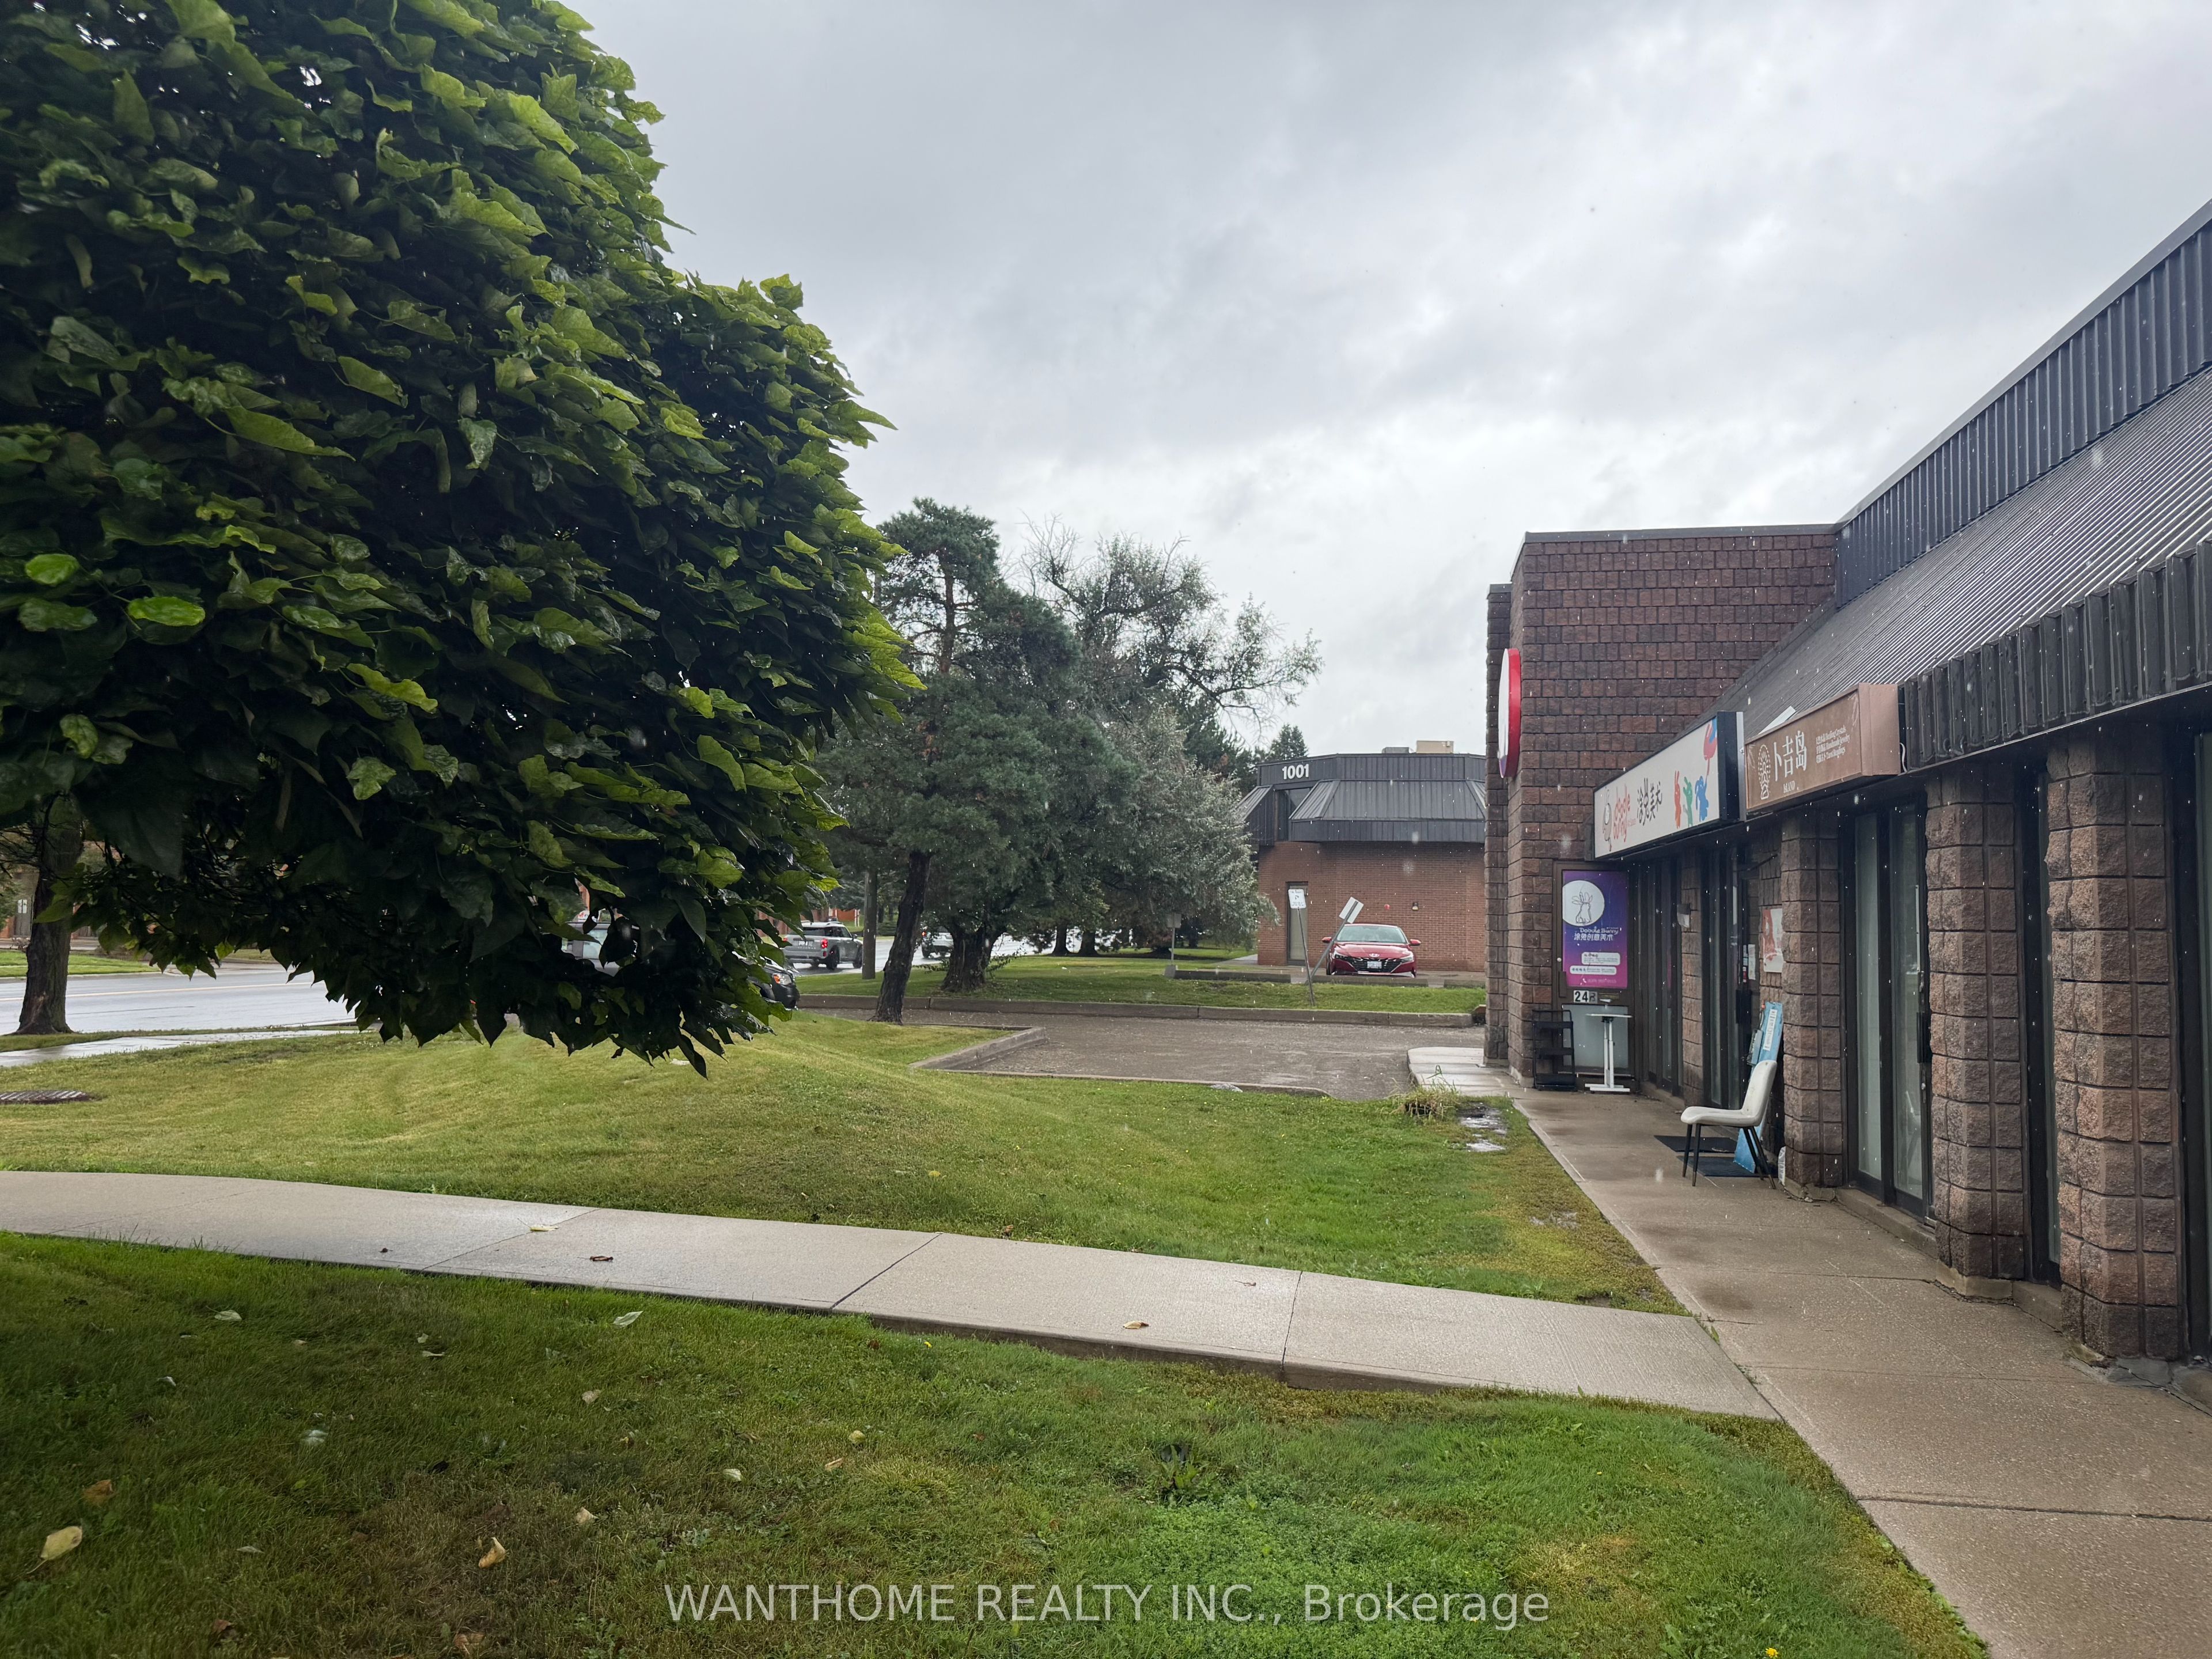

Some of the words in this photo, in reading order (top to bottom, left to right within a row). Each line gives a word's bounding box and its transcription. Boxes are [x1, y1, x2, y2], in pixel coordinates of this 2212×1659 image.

[1282, 764, 1309, 779] 1001
[1774, 730, 1807, 782] 卜吉岛
